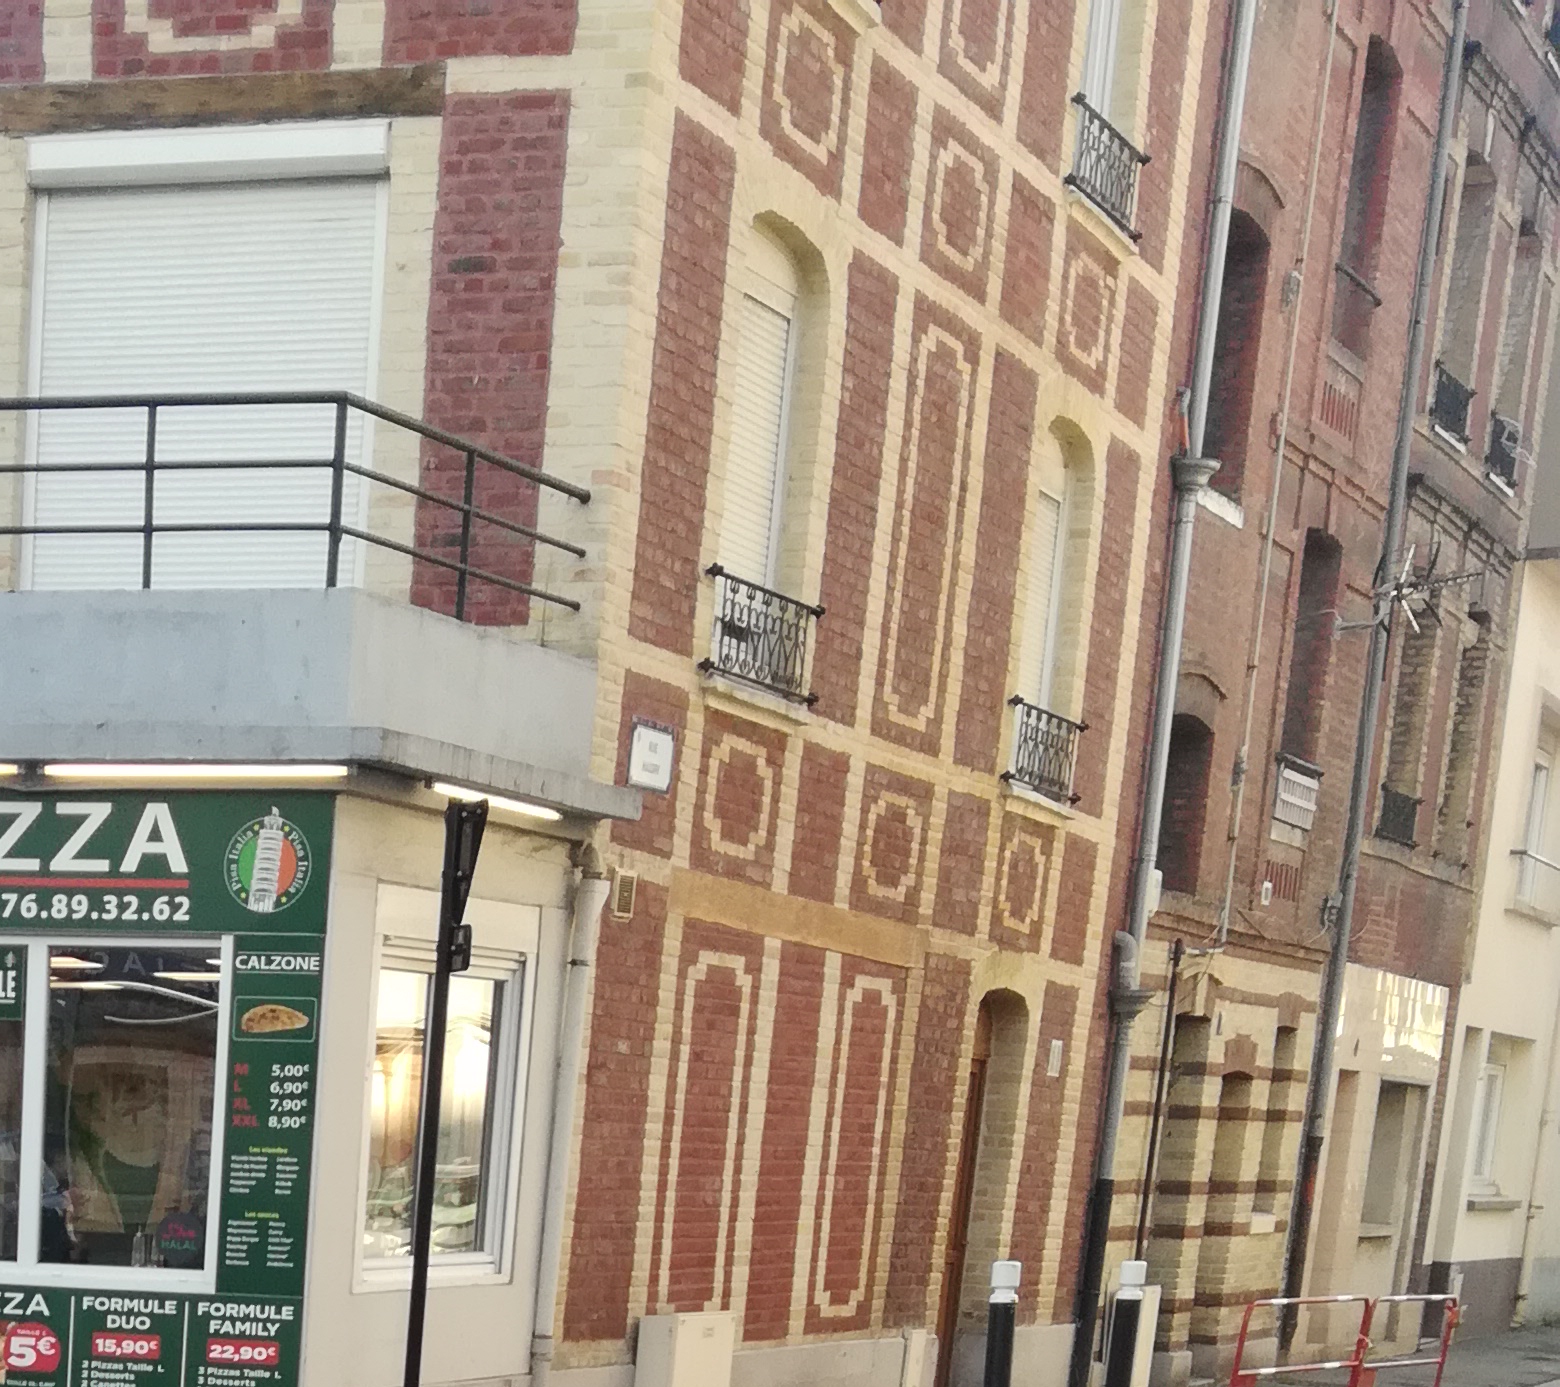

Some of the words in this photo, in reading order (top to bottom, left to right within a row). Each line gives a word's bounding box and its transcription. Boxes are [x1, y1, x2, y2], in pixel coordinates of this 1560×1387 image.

[235, 955, 320, 971] CALZONE
[271, 1064, 310, 1078] 5,00€
[234, 1080, 242, 1092] L
[270, 1081, 309, 1095] 6,90€
[270, 1099, 308, 1112] 7,90€
[268, 1116, 306, 1129] 8,90€
[82, 1296, 178, 1314] FORMULE
[197, 1302, 295, 1320] FORMULE
[106, 1314, 151, 1330] DUO
[209, 1320, 280, 1336] FAMILY
[7, 1336, 57, 1367] 5€
[95, 1338, 159, 1356] 15,90€
[209, 1344, 276, 1362] 22,90€
[91, 1360, 124, 1370] Pizzas
[207, 1367, 241, 1377] Pizzas
[90, 1370, 135, 1381] Desserts
[207, 1377, 256, 1387] Desserts
